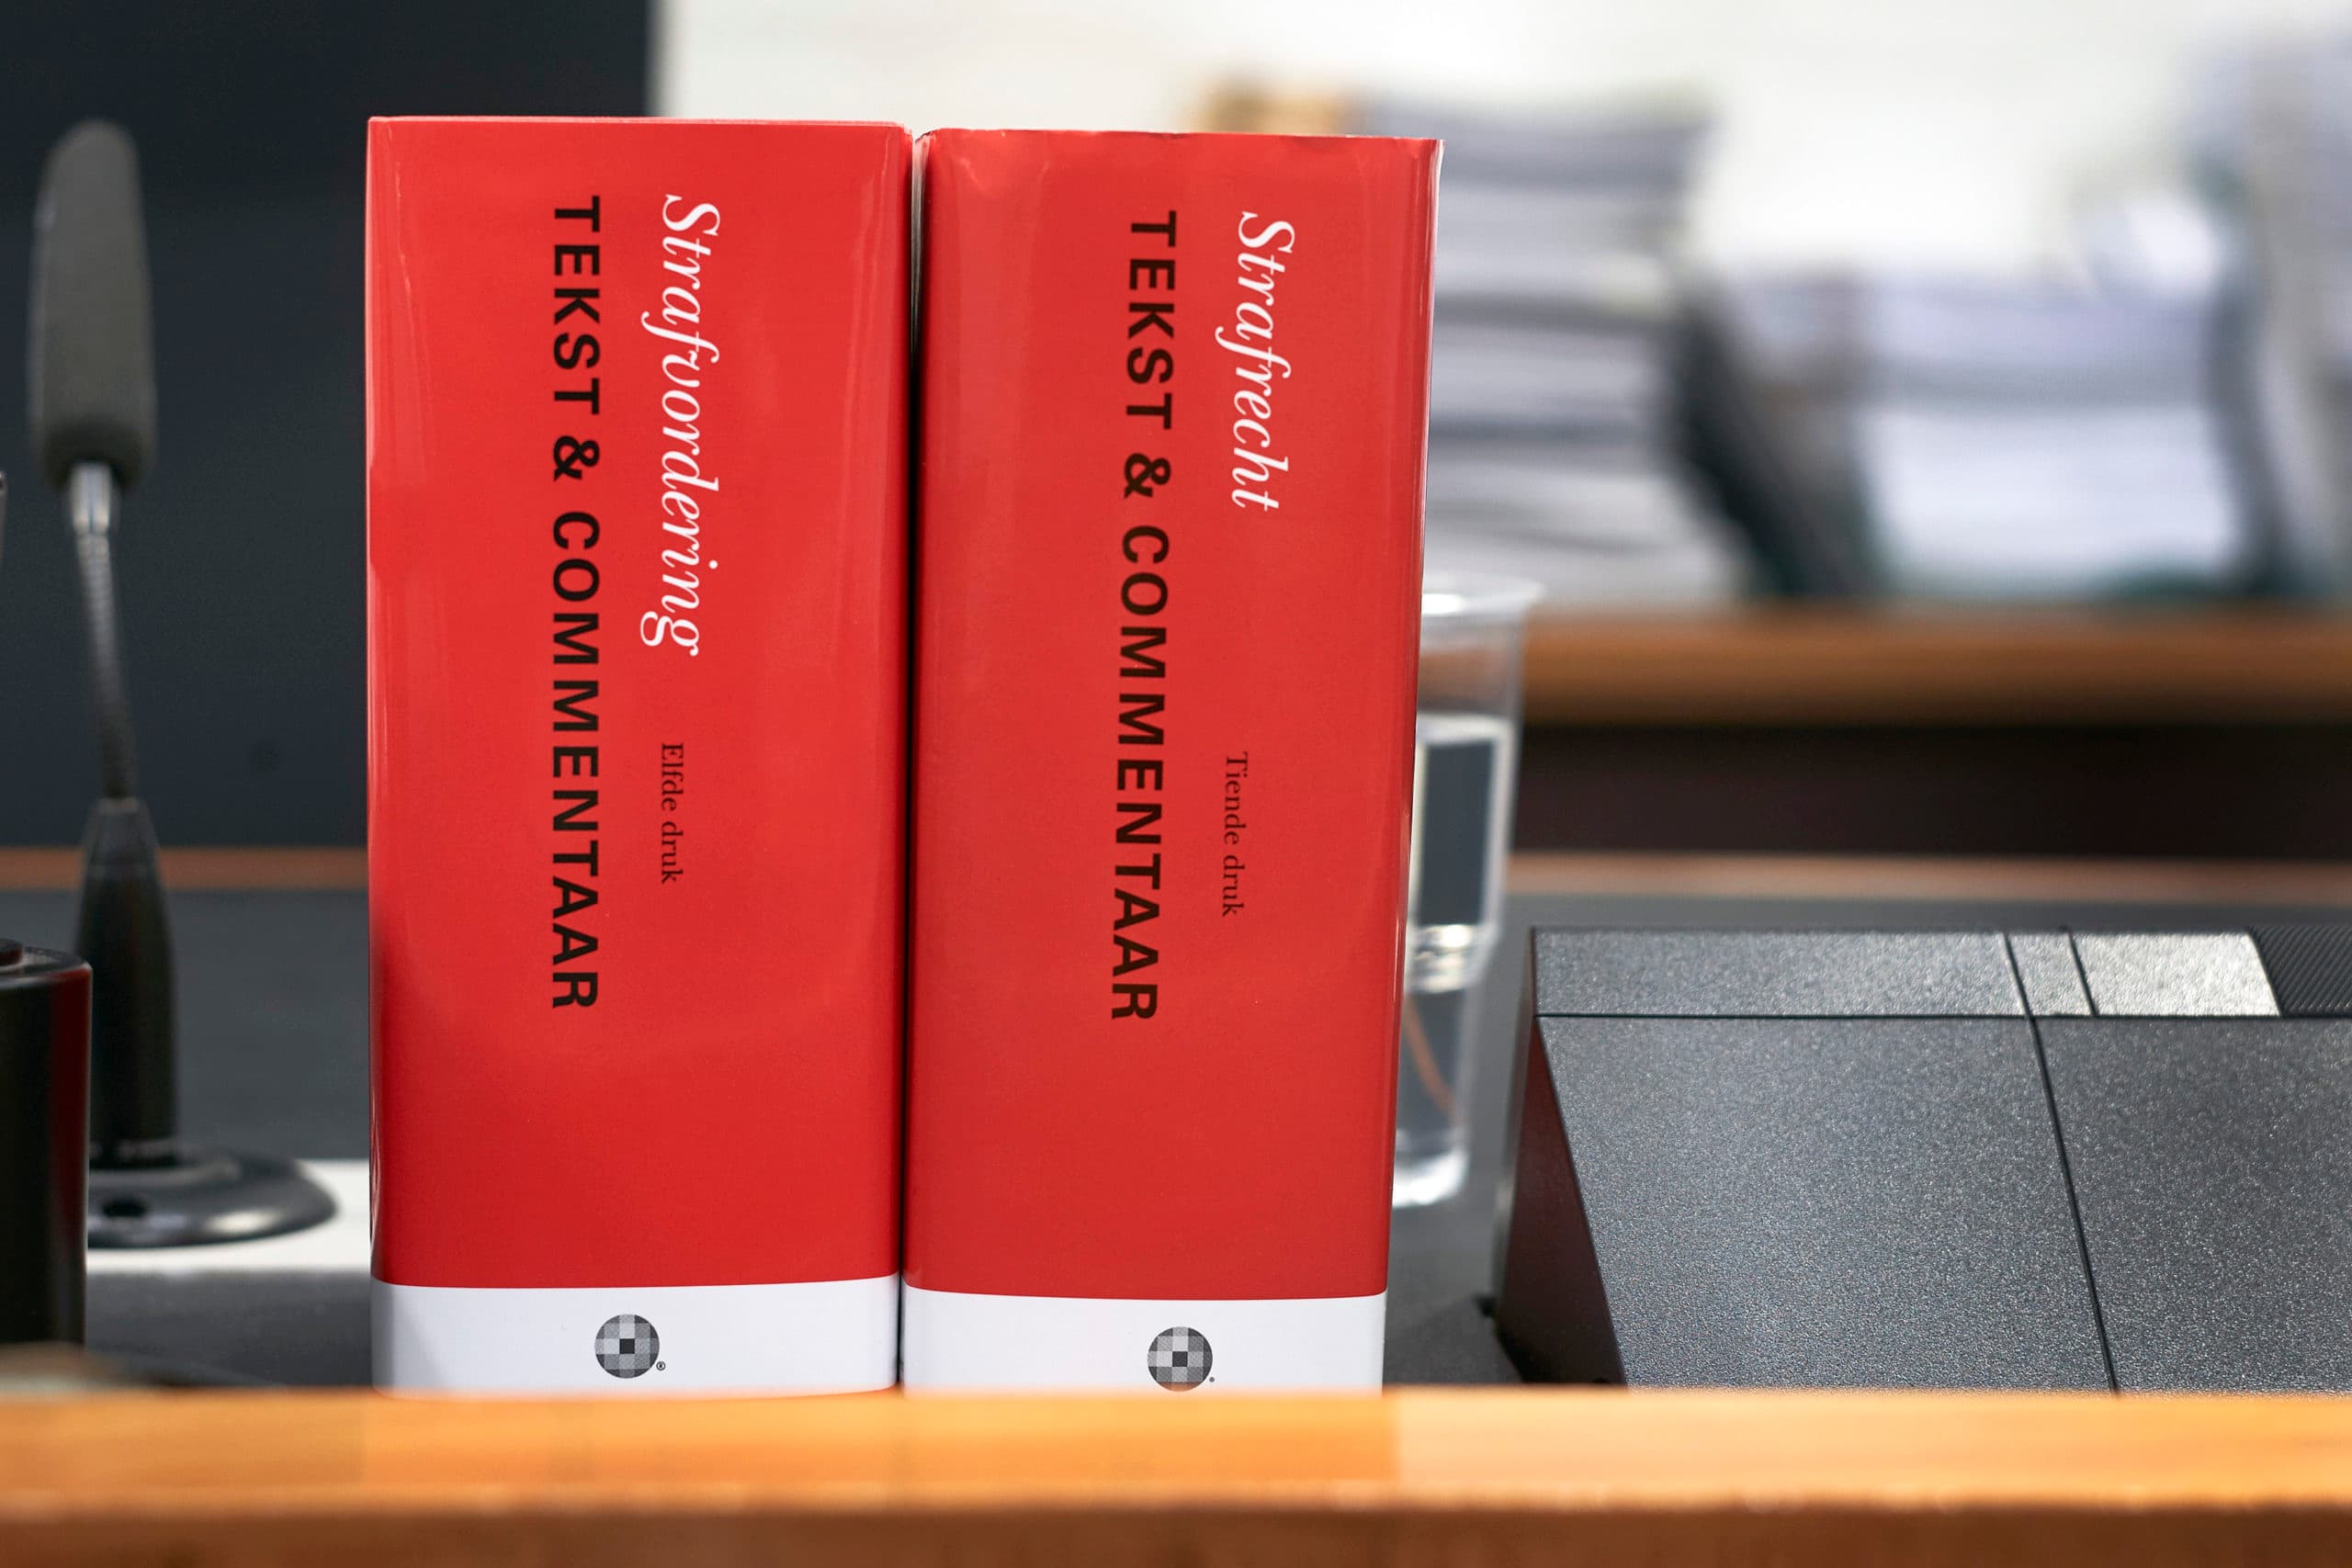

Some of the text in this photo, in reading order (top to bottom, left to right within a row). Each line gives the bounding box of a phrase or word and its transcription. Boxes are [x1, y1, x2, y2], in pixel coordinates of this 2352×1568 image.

[640, 194, 721, 658] Strafvordering
[1215, 210, 1295, 512] Strafrecht
[551, 195, 600, 1010] TEKST & COMMENTAAR
[1111, 209, 1177, 1021] TEKST & COMMENTAAR
[661, 742, 684, 884] Elfde druk
[1221, 751, 1249, 917] Tiende druk
